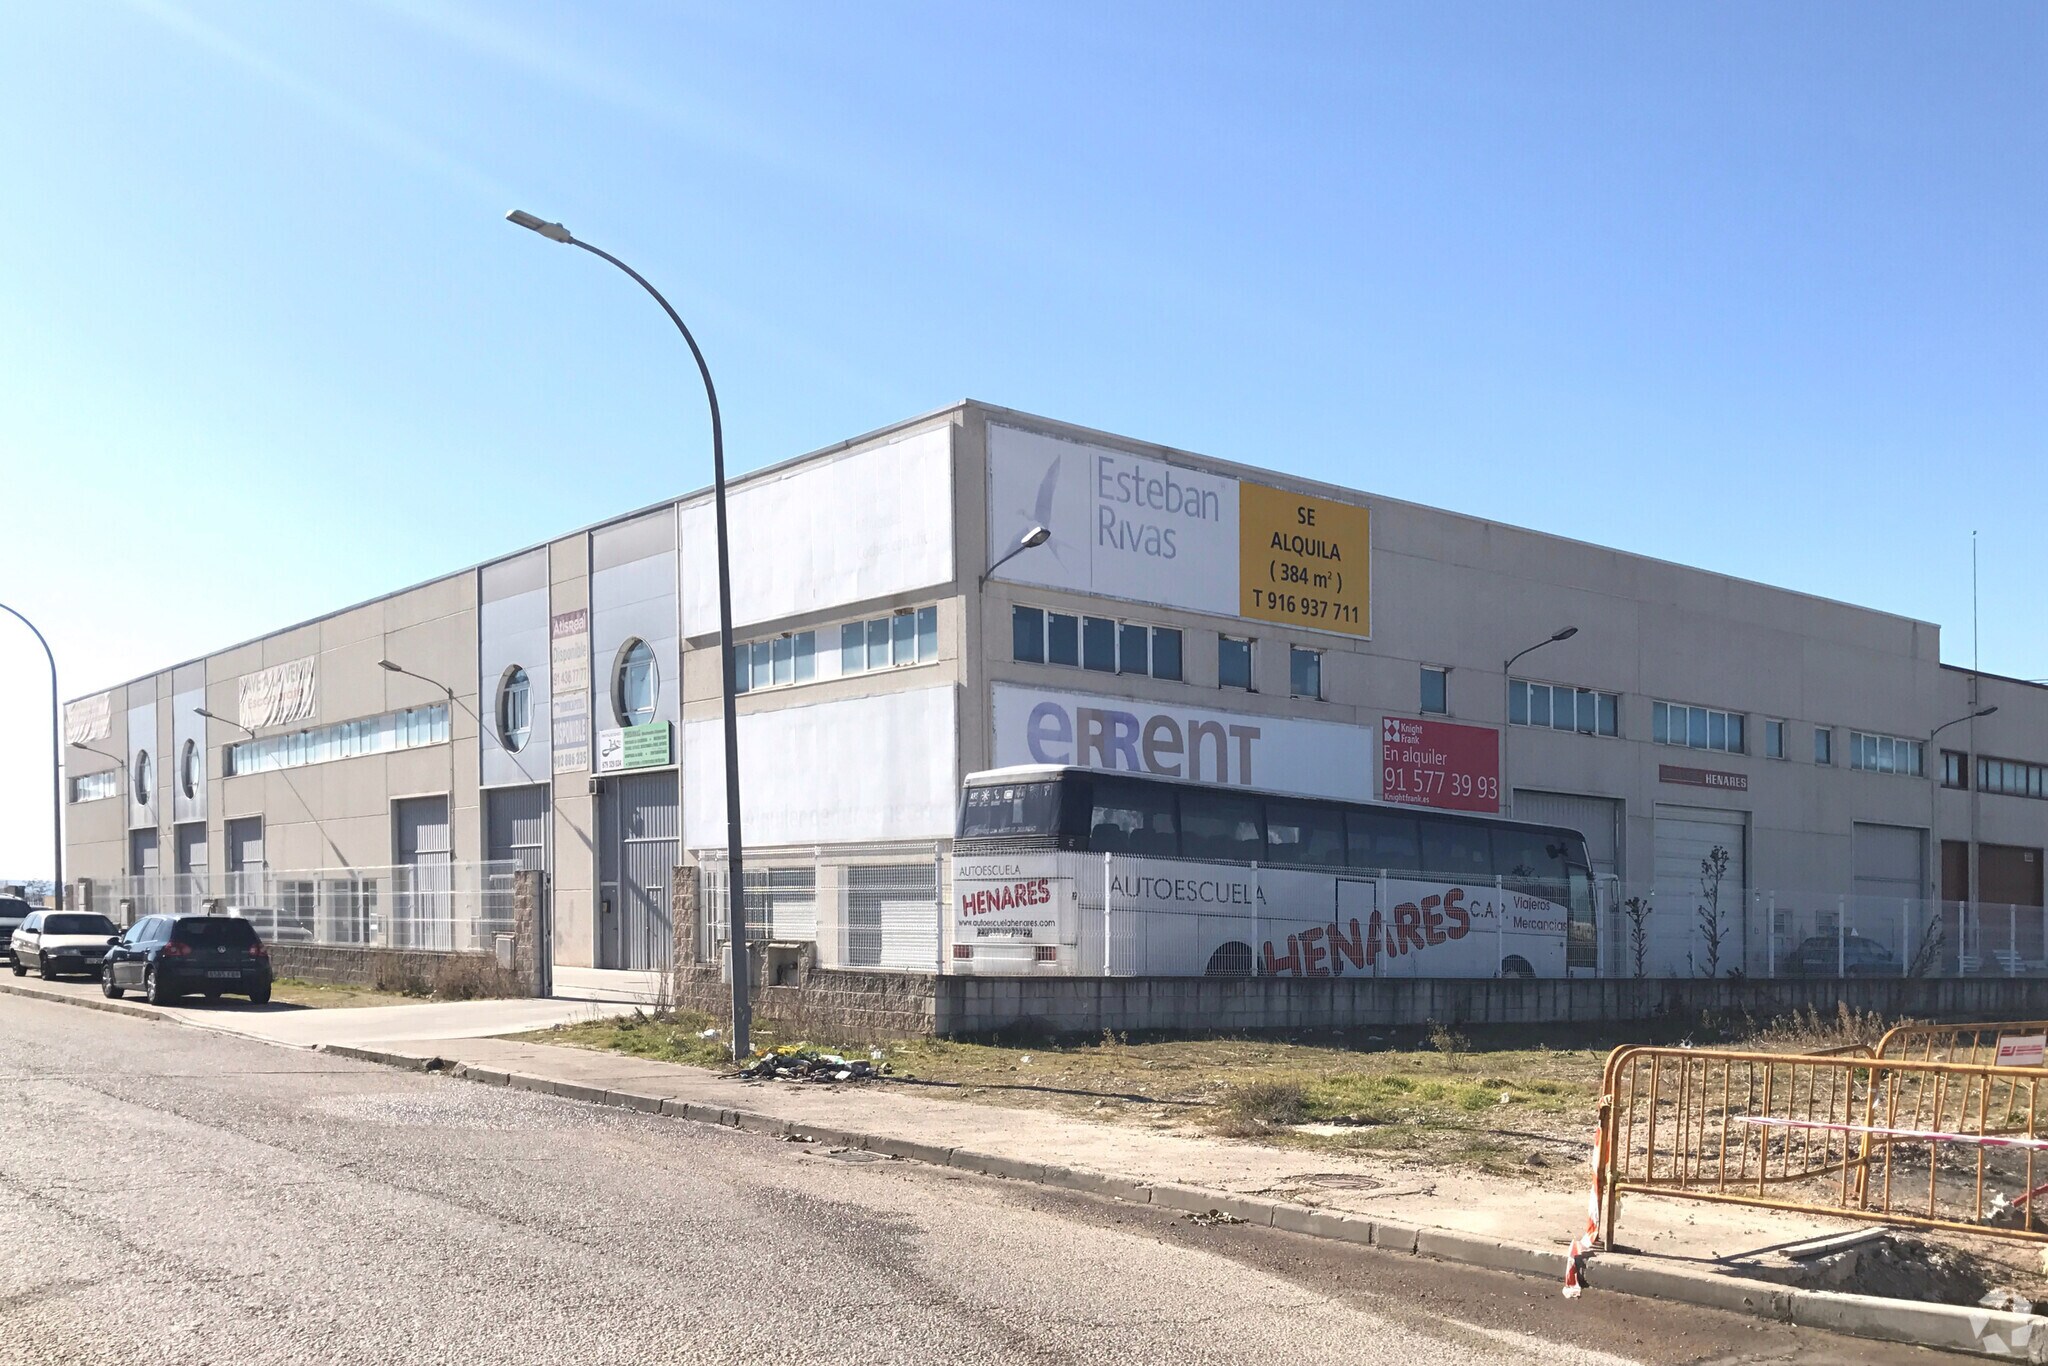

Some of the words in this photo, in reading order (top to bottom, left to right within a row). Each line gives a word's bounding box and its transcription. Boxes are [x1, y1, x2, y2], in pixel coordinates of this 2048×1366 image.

[1099, 456, 1219, 522] Esteban
[1298, 506, 1315, 526] SE
[1270, 531, 1341, 561] ALQUILA
[1281, 563, 1309, 585] 384
[1253, 589, 1263, 607] T
[1268, 592, 1295, 613] 916
[1301, 598, 1328, 618] 937
[1333, 603, 1358, 623] 711
[1401, 724, 1423, 735] Knight
[1401, 734, 1420, 744] Frank
[1384, 745, 1399, 761] En
[1402, 747, 1447, 767] alquiler
[1385, 767, 1406, 791] 91
[1414, 769, 1445, 794] 577
[1451, 773, 1472, 797] 39
[1477, 776, 1498, 799] 93
[1705, 774, 1747, 788] HENARES
[959, 865, 1021, 877] AUTOESCUELA
[962, 879, 1051, 917] HENARES
[1111, 874, 1267, 905] AUTOESCUELA
[1513, 896, 1551, 911] Viajeros
[1263, 888, 1470, 977] HENARES
